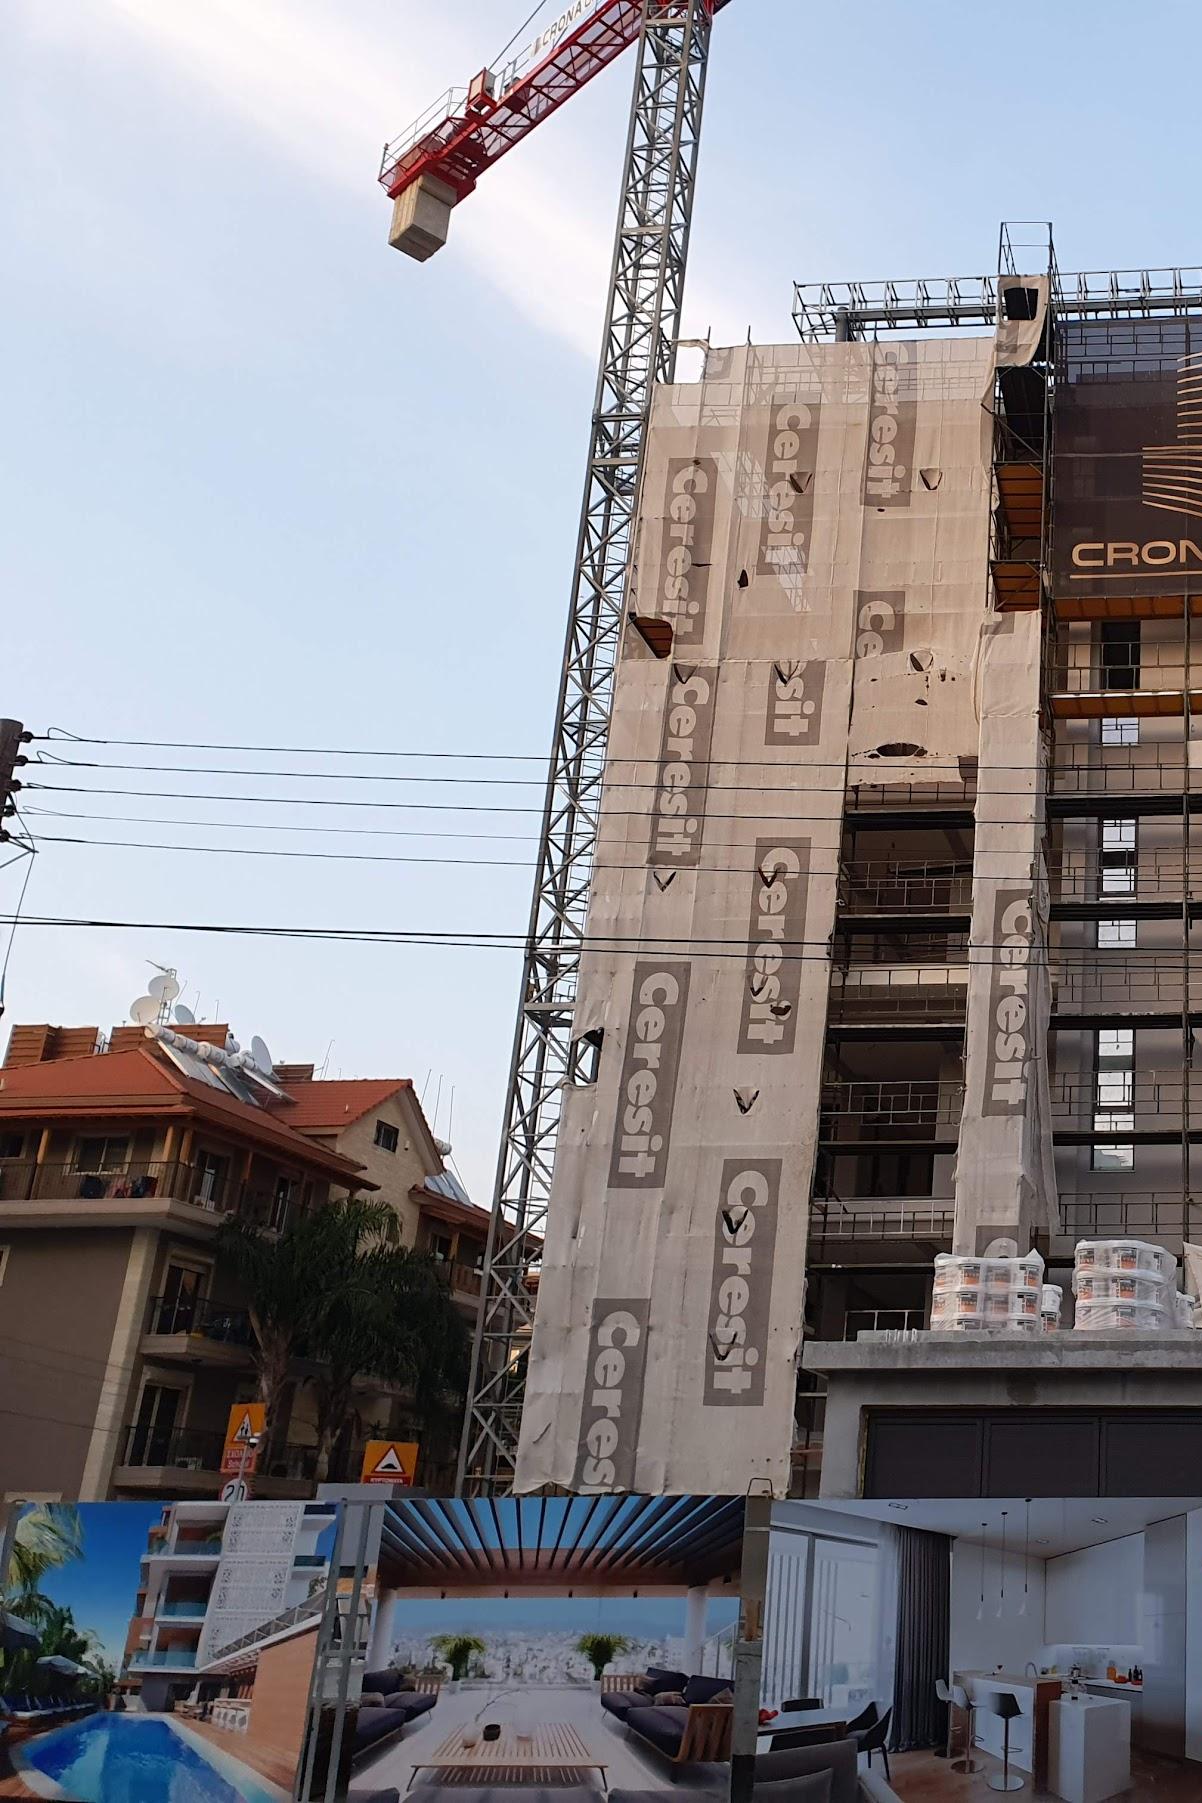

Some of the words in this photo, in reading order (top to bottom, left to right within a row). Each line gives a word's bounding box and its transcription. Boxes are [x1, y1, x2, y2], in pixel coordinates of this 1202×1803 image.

[543, 0, 582, 45] CRONA
[663, 465, 708, 636] Ceresit
[655, 677, 709, 858] Ceresit
[747, 848, 799, 1044] Ceresit
[992, 900, 1033, 1104] Ceresit
[618, 972, 680, 1178] Ceresit
[713, 1170, 769, 1394] Ceresit
